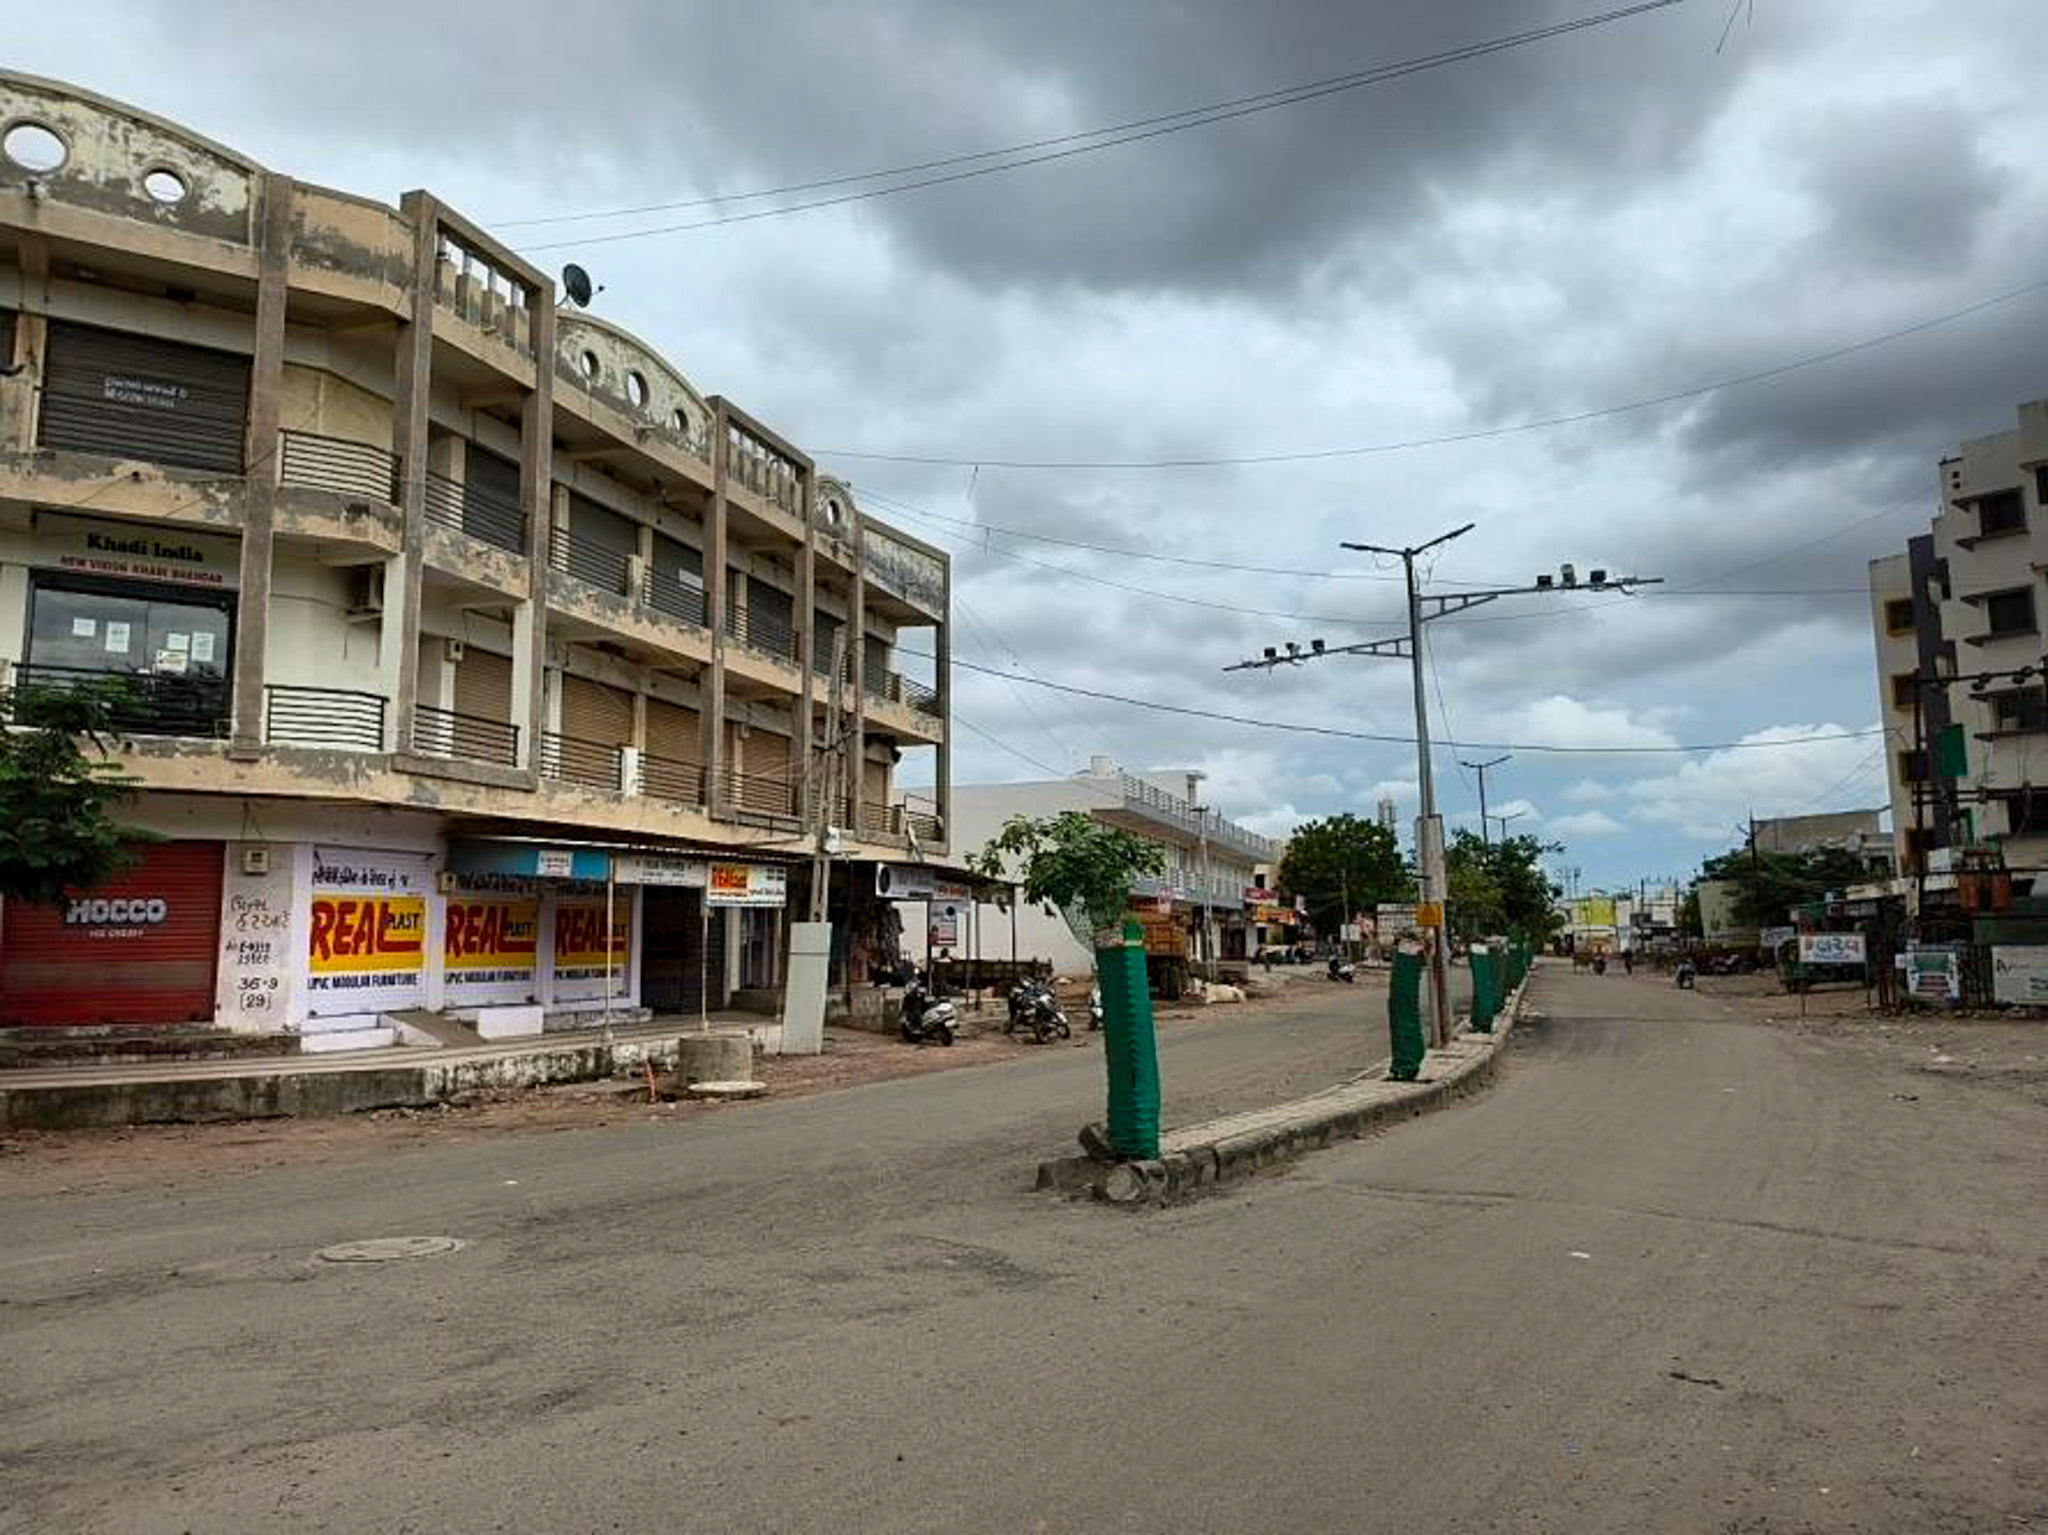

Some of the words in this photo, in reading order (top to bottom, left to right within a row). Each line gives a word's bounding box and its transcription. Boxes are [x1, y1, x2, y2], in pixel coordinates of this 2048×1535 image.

[86, 533, 147, 555] Khadi
[154, 542, 203, 562] India
[65, 898, 167, 924] HOCCO
[309, 901, 421, 961] REAL
[446, 904, 536, 958] REAL
